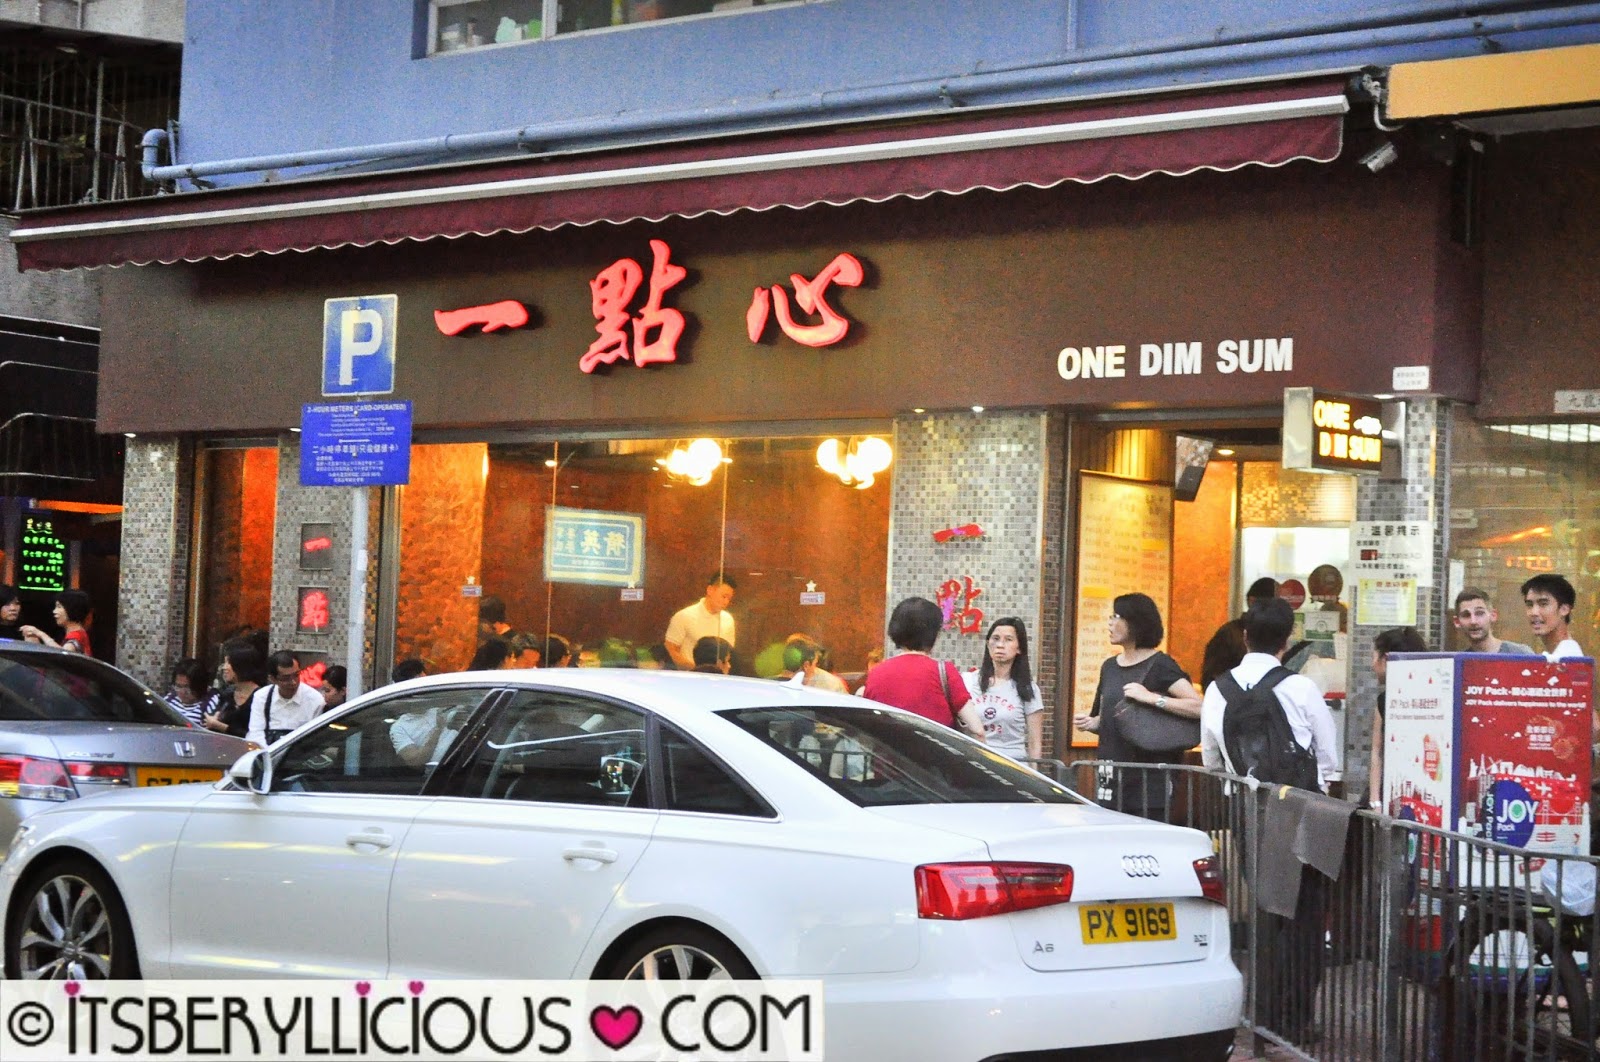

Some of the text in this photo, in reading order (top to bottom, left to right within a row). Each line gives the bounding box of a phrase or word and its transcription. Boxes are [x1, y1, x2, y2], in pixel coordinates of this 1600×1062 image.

[434, 239, 864, 374] 一點心
[339, 309, 383, 385] P
[1057, 337, 1293, 380] ONE DIM SUM
[1313, 400, 1350, 430] ONE
[1319, 431, 1381, 462] DIM SUM
[932, 523, 986, 672] 一點
[1465, 686, 1484, 695] JOY
[1486, 792, 1494, 813] JOY
[1496, 799, 1539, 823] JOY
[1497, 823, 1515, 831] Pack
[1087, 907, 1170, 939] PX 9169
[1032, 940, 1054, 953] A6
